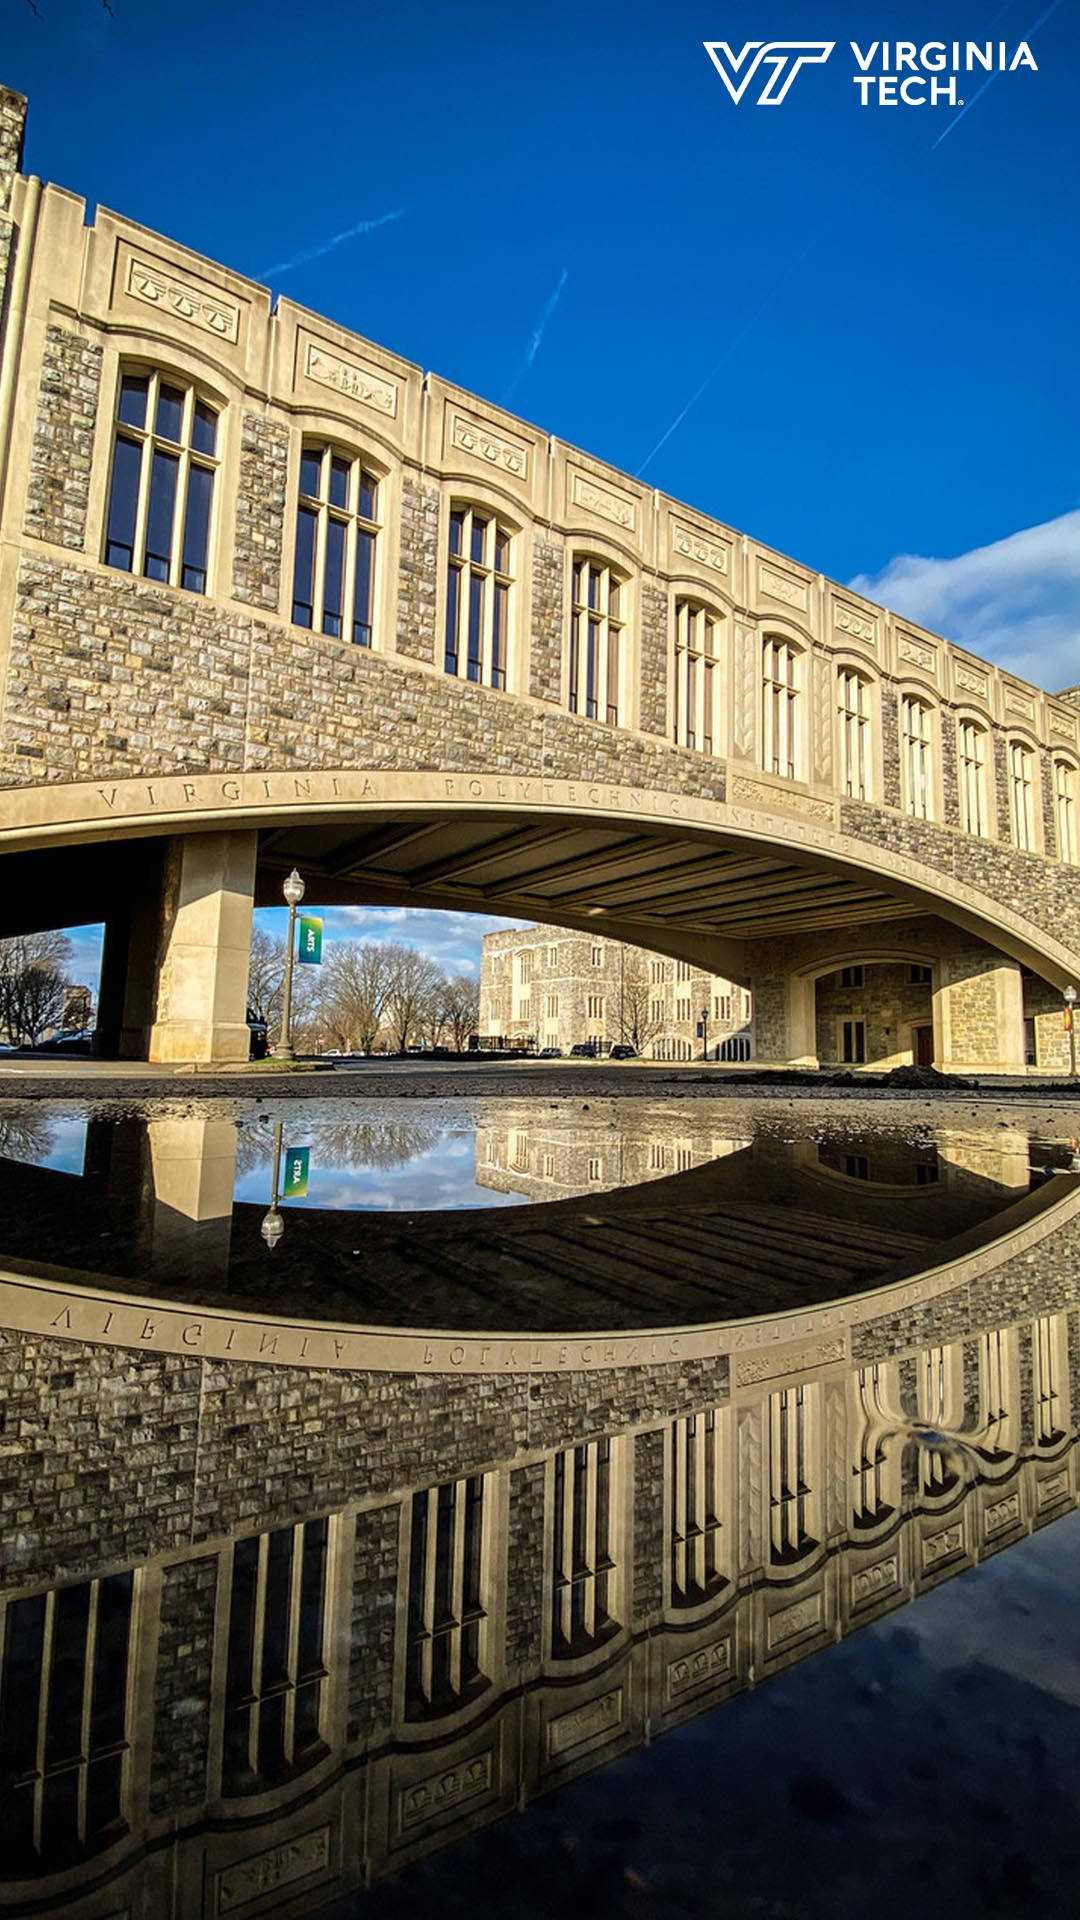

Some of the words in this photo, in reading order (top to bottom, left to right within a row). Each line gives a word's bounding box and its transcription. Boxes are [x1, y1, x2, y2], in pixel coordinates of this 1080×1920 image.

[96, 778, 378, 808] VIRGINIA
[444, 779, 681, 814] POLYTECHNIC
[307, 929, 316, 952] ARTS
